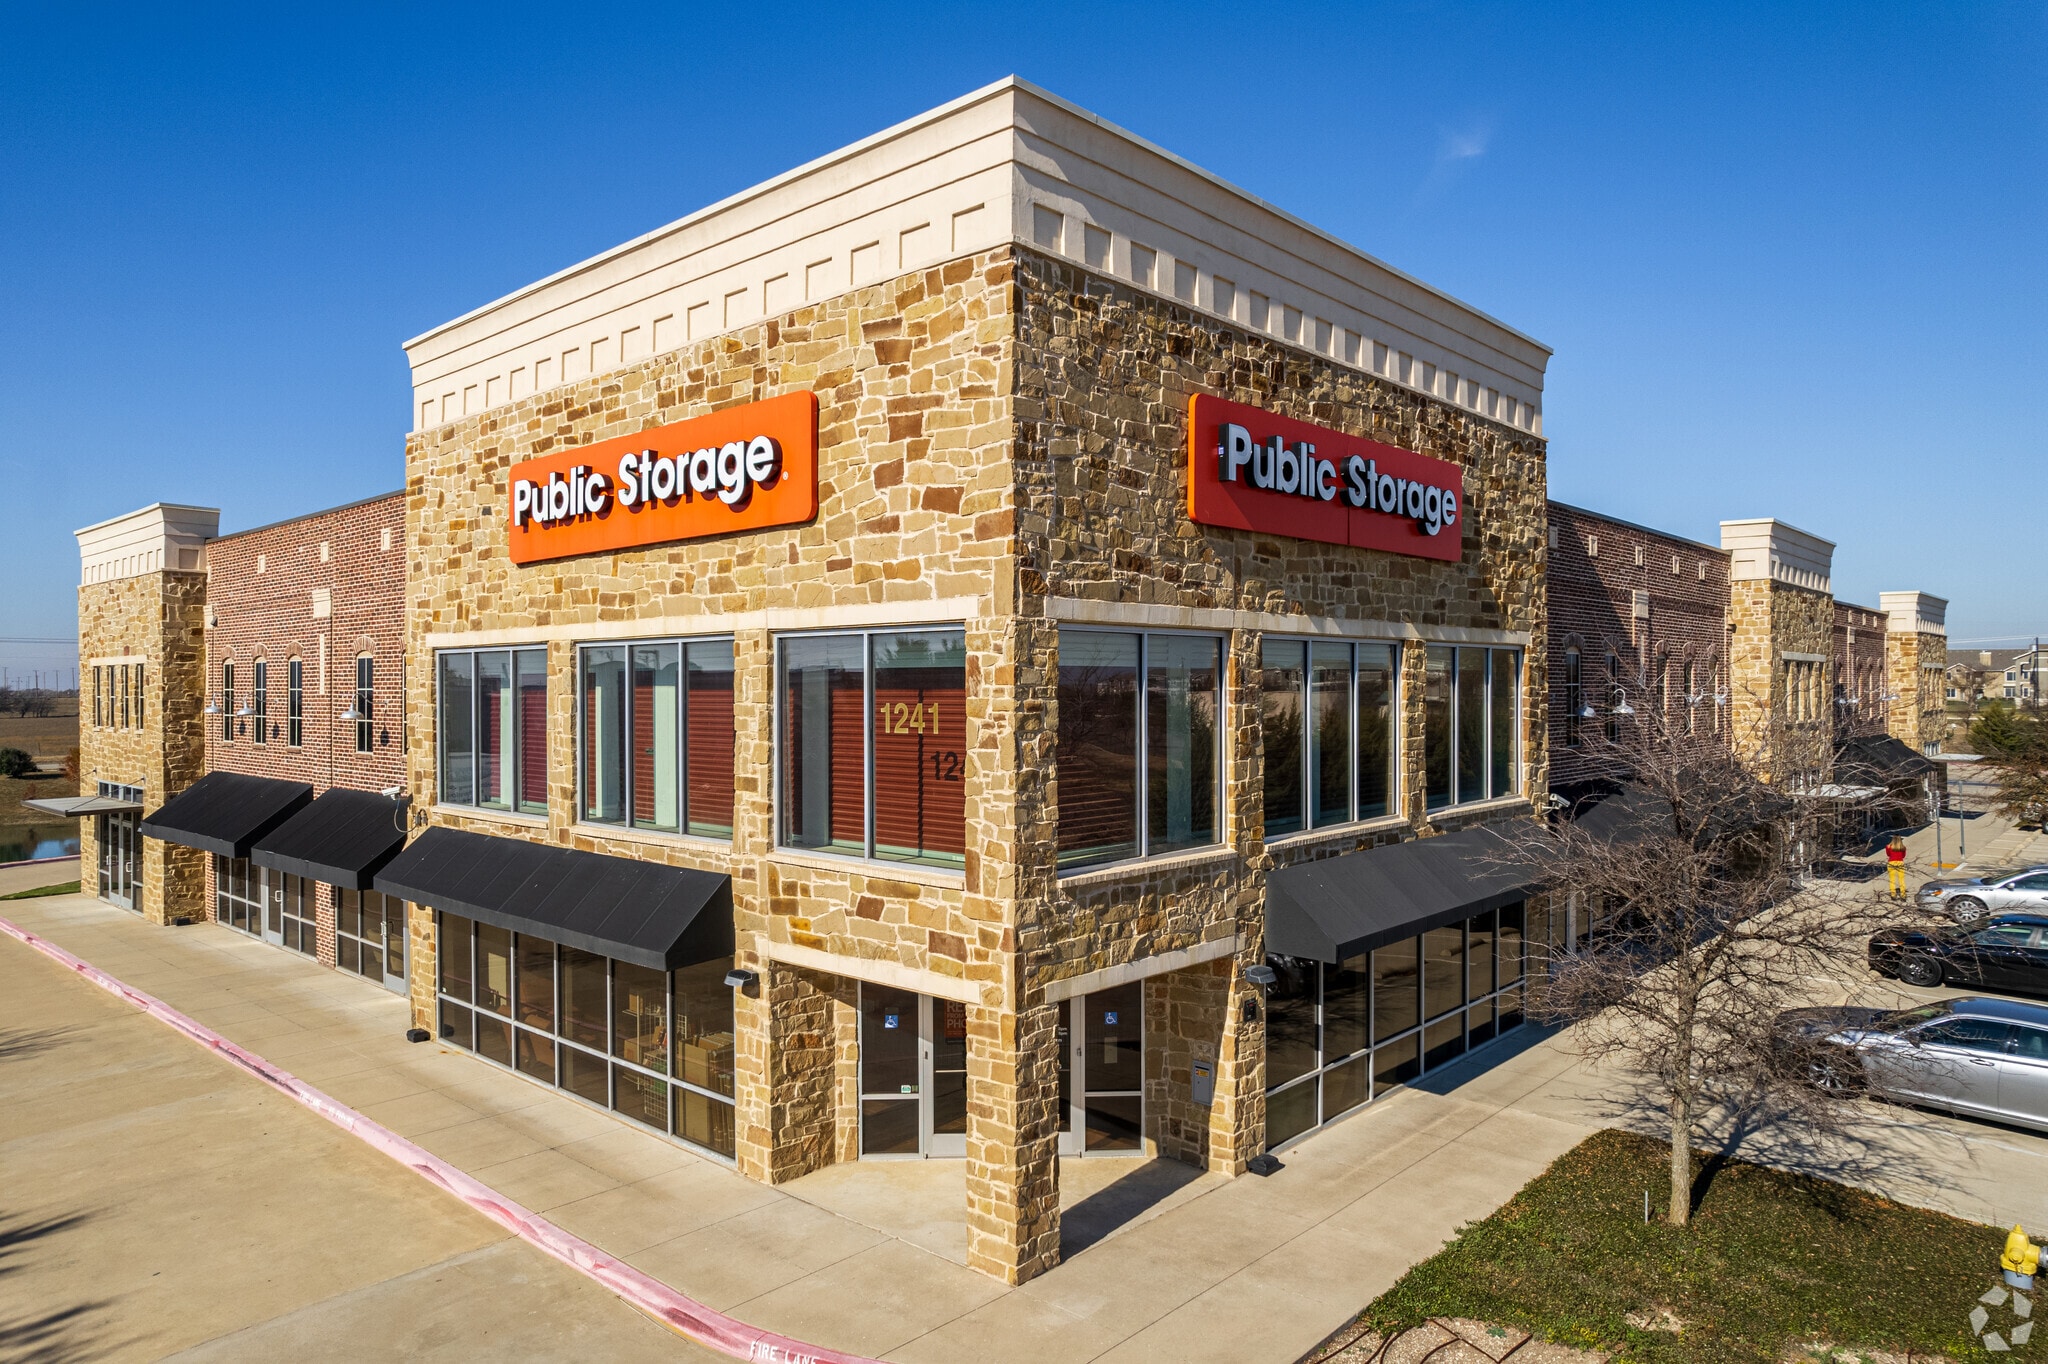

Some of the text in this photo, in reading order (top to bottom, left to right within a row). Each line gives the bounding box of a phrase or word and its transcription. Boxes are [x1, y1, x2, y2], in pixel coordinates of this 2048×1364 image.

[513, 435, 777, 527] Public Storage
[1224, 423, 1457, 536] Public Storage
[880, 702, 939, 735] 1241
[931, 750, 966, 782] 12
[749, 1340, 779, 1362] FIRE
